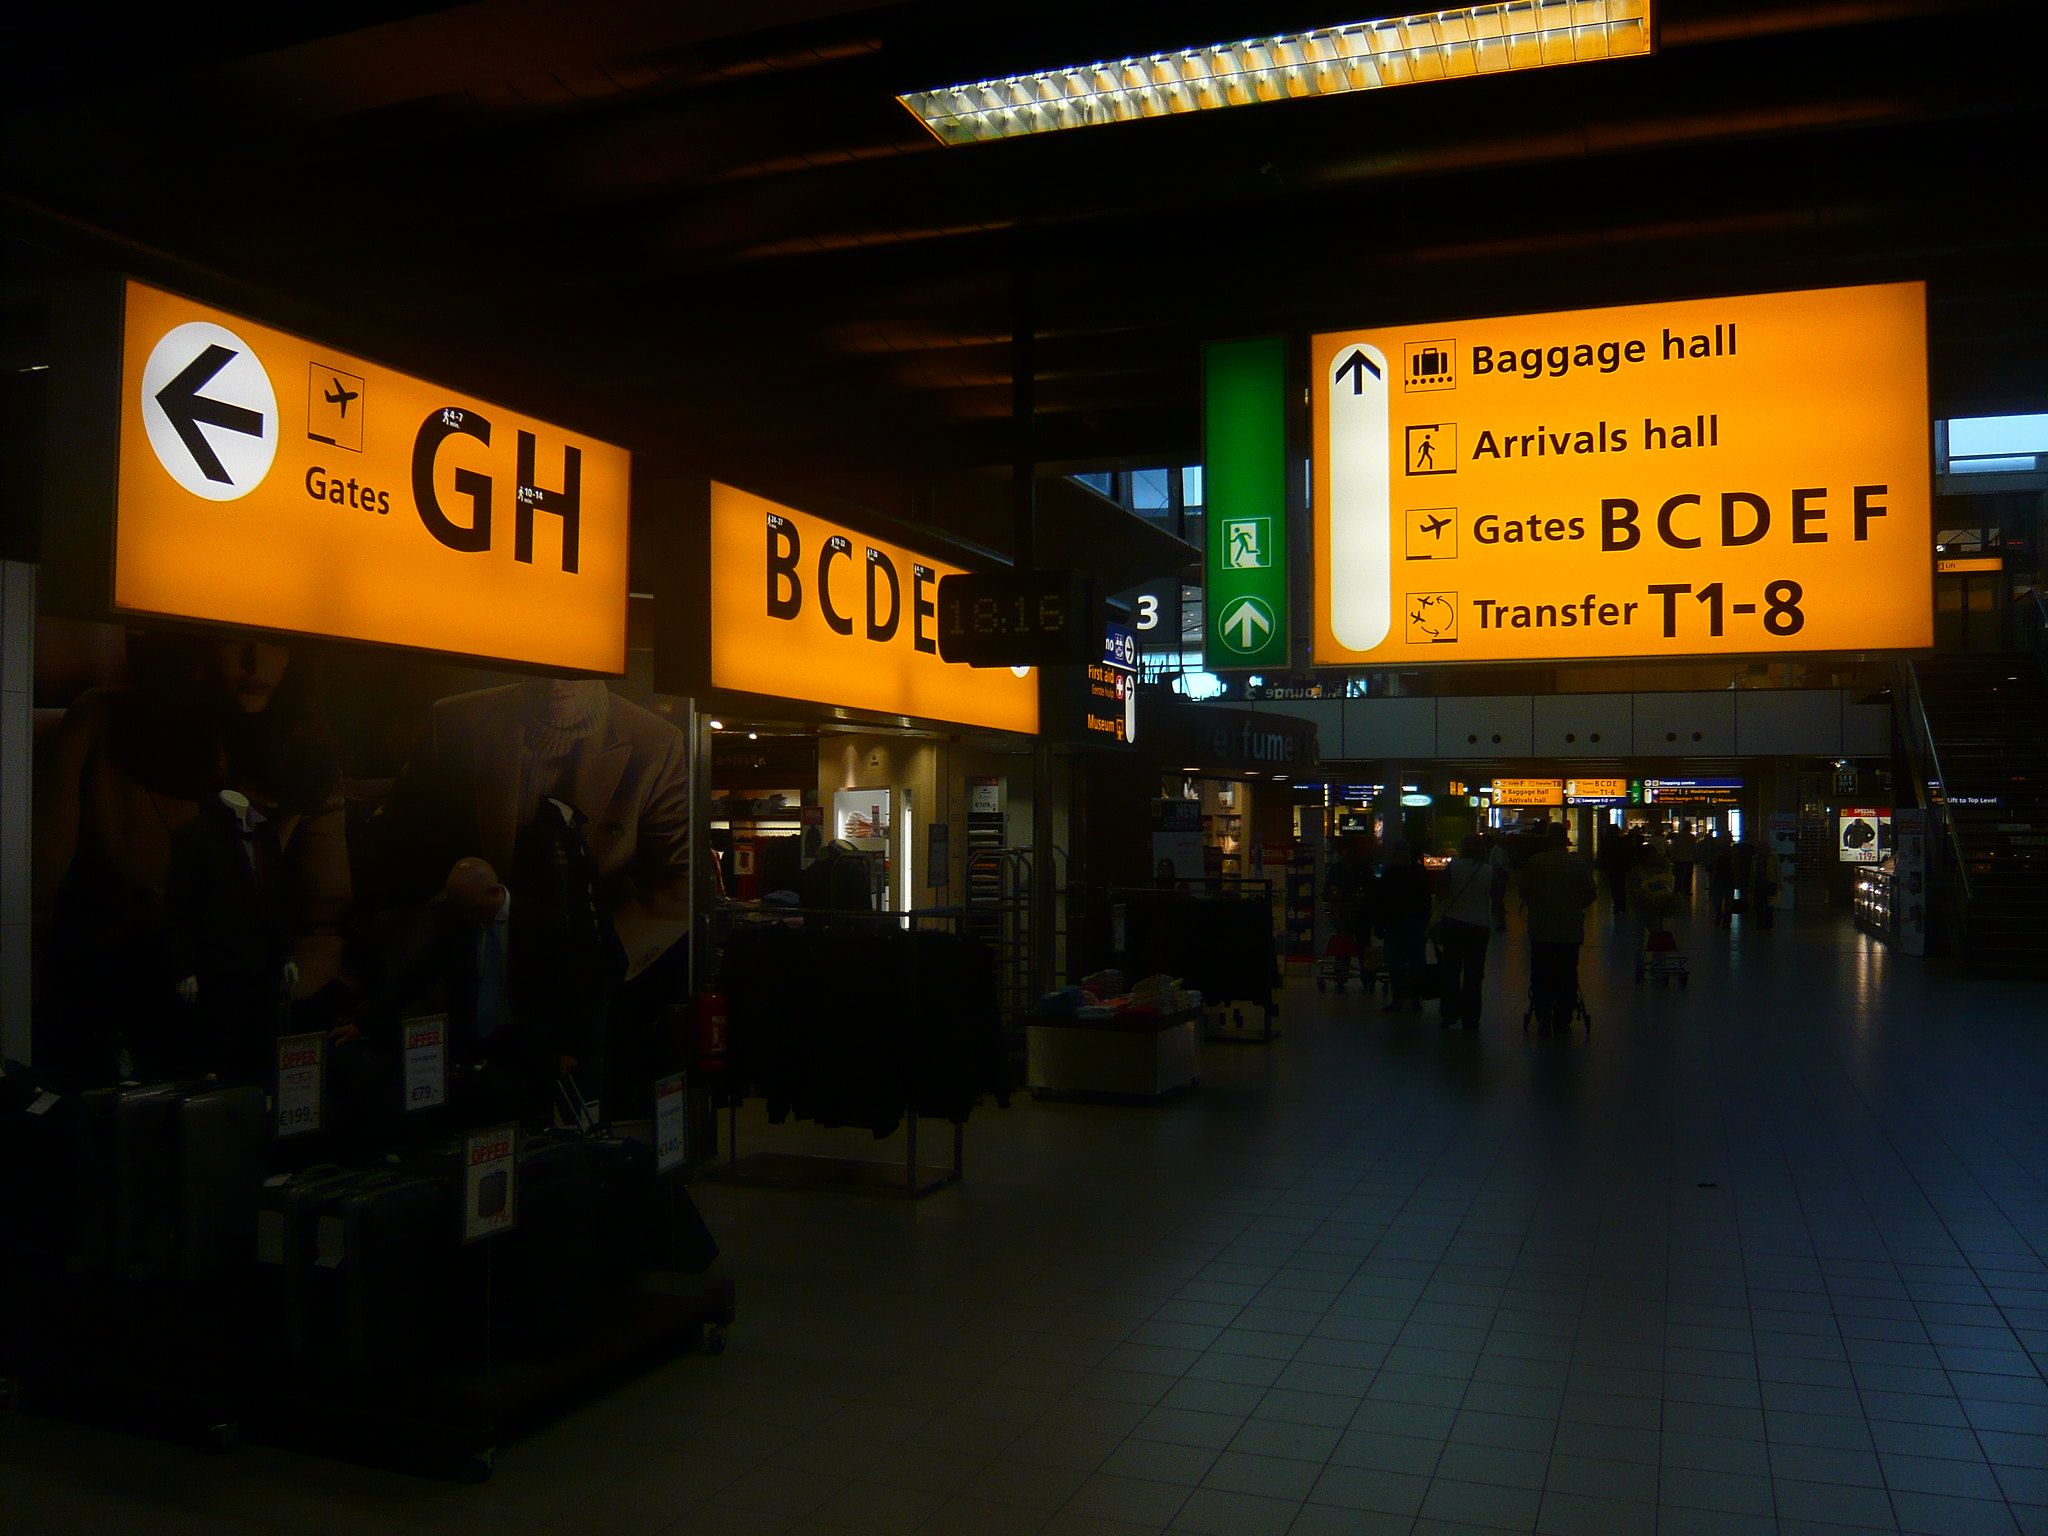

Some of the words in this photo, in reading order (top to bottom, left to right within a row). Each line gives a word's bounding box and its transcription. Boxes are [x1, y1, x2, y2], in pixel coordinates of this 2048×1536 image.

[1473, 341, 1646, 379] Baggage
[1662, 323, 1737, 360] hall
[1472, 421, 1627, 460] Arrivals
[1644, 414, 1718, 450] hall
[305, 466, 390, 515] Gates
[524, 487, 544, 500] 10-14
[1473, 514, 1585, 544] Gates
[1136, 595, 1159, 631] 3
[1473, 594, 1638, 629] Transfer
[1648, 579, 1805, 638] T1-8
[1088, 664, 1103, 681] First
[1104, 667, 1115, 684] aid
[1087, 713, 1115, 732] Museum
[1967, 796, 1979, 805] Top
[1979, 796, 1997, 804] Level
[408, 1030, 441, 1047] OFFER
[283, 1048, 317, 1068] OFFER
[471, 1140, 510, 1163] OFFER
